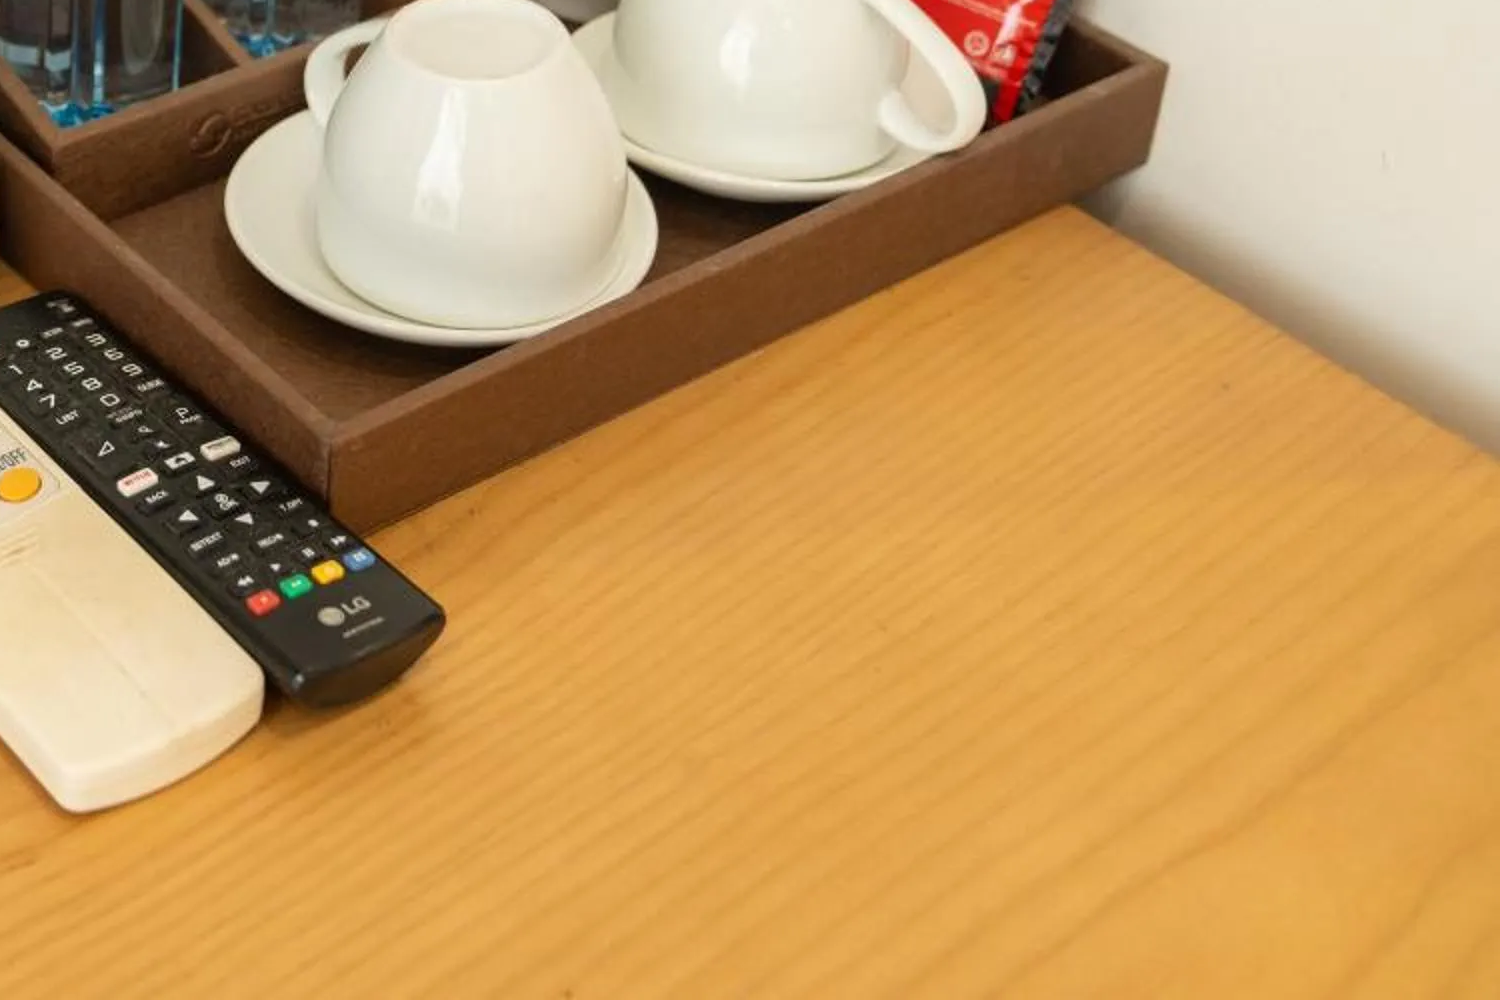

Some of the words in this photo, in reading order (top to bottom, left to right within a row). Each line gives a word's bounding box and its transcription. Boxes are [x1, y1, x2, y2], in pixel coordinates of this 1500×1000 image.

[8, 363, 24, 376] 1
[46, 346, 68, 361] 2
[85, 332, 107, 347] 3
[26, 378, 44, 393] 4
[62, 361, 85, 376] 5
[102, 347, 125, 362] 6
[39, 393, 57, 409] 7
[81, 376, 103, 392] 8
[121, 363, 144, 378] 9
[55, 409, 82, 426] LIST
[99, 392, 121, 408] 0
[175, 407, 189, 419] P
[229, 455, 251, 469] EXIT
[145, 489, 169, 504] BACK
[219, 497, 240, 512] OK
[341, 596, 373, 615] LG
